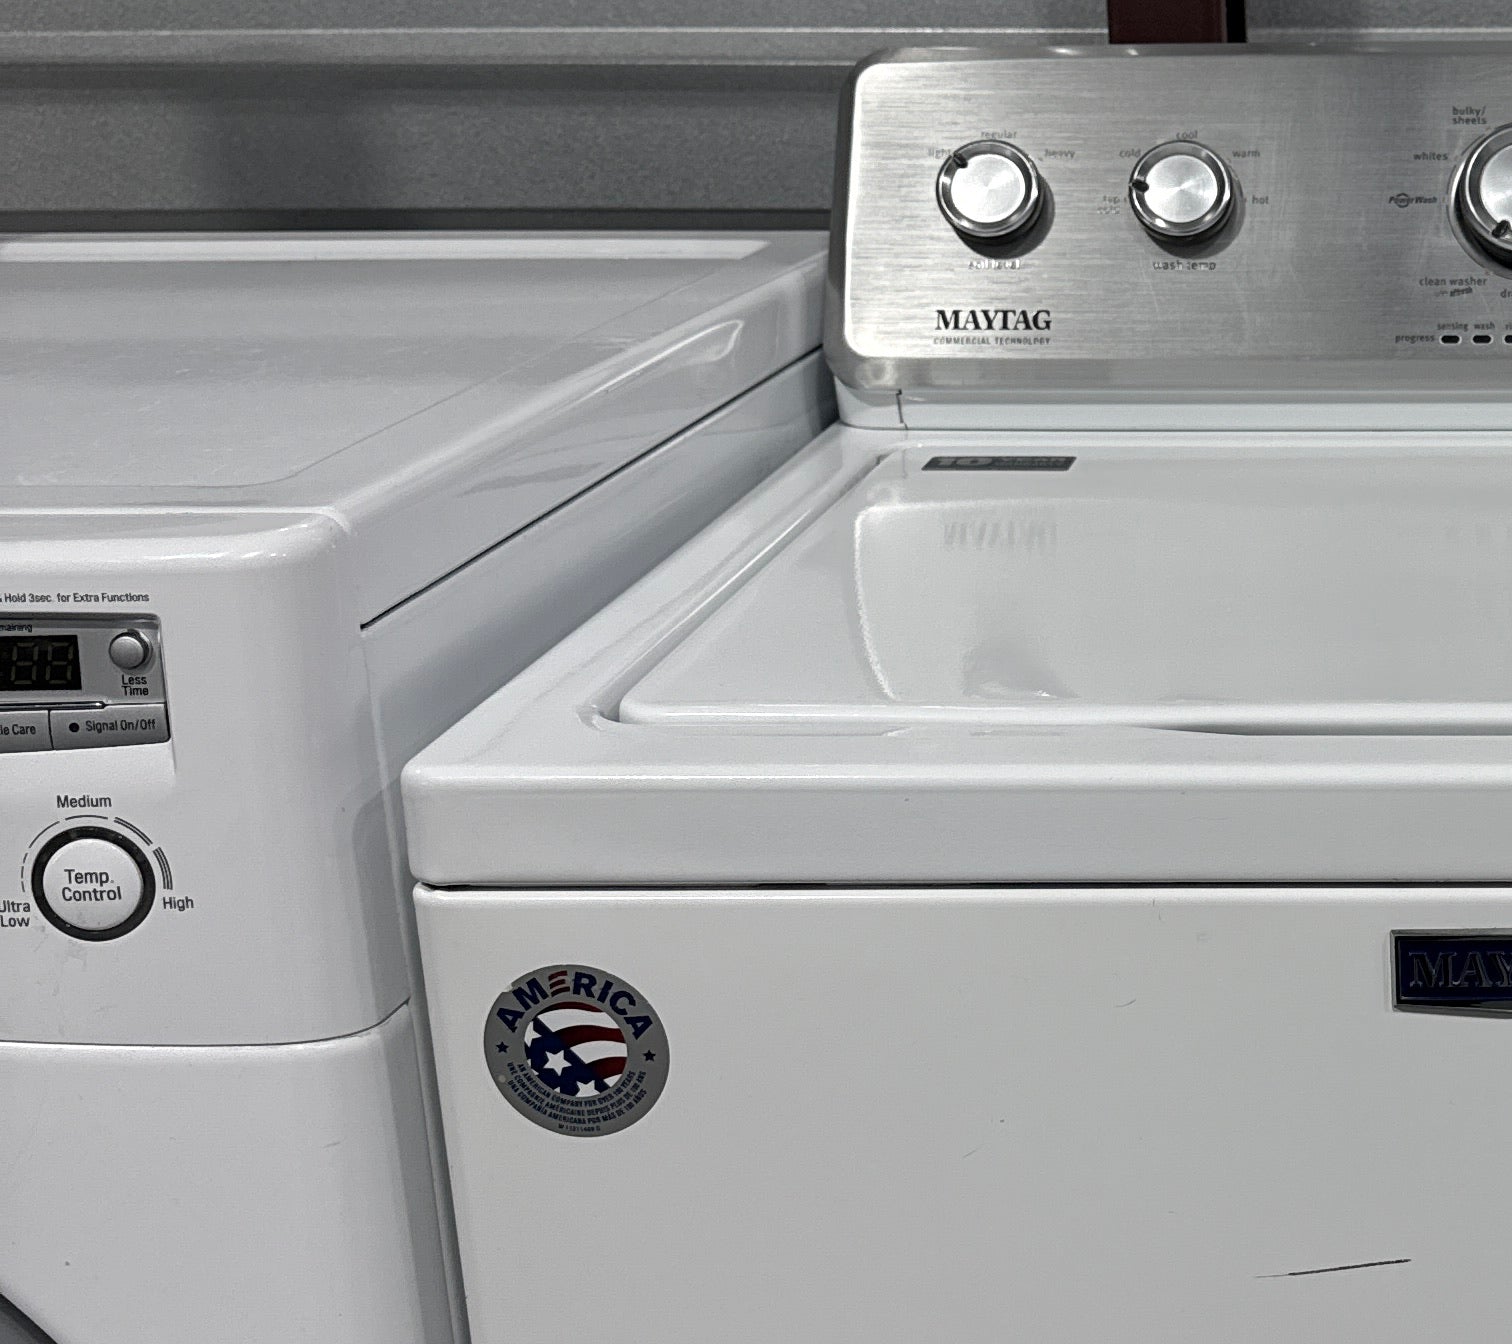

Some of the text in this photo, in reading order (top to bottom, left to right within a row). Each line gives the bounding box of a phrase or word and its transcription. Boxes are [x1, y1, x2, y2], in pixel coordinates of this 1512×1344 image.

[1452, 107, 1486, 117] bulky/
[1452, 116, 1487, 125] sheets
[1232, 149, 1260, 157] warm
[1413, 152, 1448, 161] whites
[1252, 195, 1269, 204] hot
[1419, 277, 1487, 286] clean washer
[935, 309, 1052, 330] MAYTAG
[1437, 322, 1469, 332] sensing
[1474, 322, 1495, 330] wash
[1395, 334, 1435, 344] progress
[5, 593, 26, 602] Hold
[57, 593, 71, 602] for
[73, 593, 99, 602] Extra
[102, 593, 149, 602] Functions
[122, 674, 147, 685] Less
[122, 685, 149, 696] Time
[12, 724, 36, 735] Care
[85, 719, 156, 734] Signal On/Off
[57, 794, 112, 808] Medium
[64, 868, 114, 886] Temp.
[62, 886, 122, 902] Control
[163, 896, 194, 910] High
[0, 915, 30, 927] Low
[496, 970, 653, 1040] AMERICA
